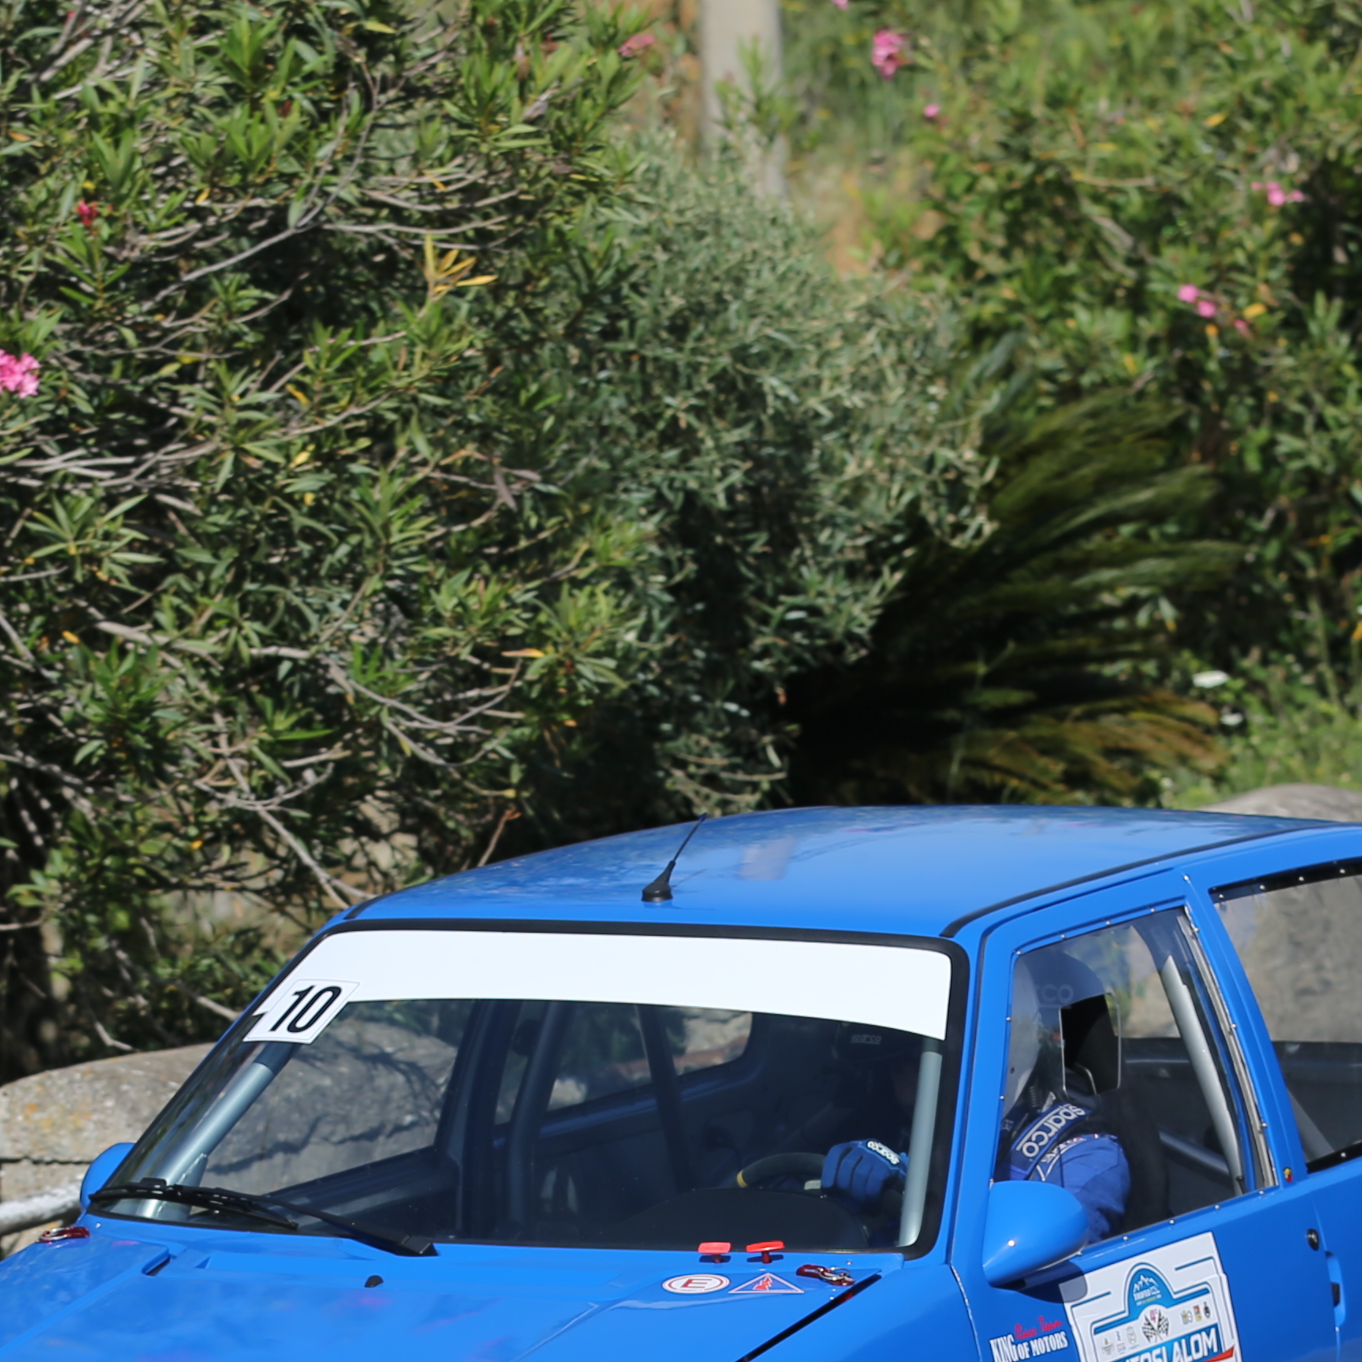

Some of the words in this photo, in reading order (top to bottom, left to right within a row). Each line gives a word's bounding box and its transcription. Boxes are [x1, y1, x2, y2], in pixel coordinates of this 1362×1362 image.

[269, 985, 342, 1033] 10
[1022, 1105, 1086, 1157] sparco
[1017, 1341, 1030, 1361] OF
[1030, 1331, 1069, 1356] MOTORS
